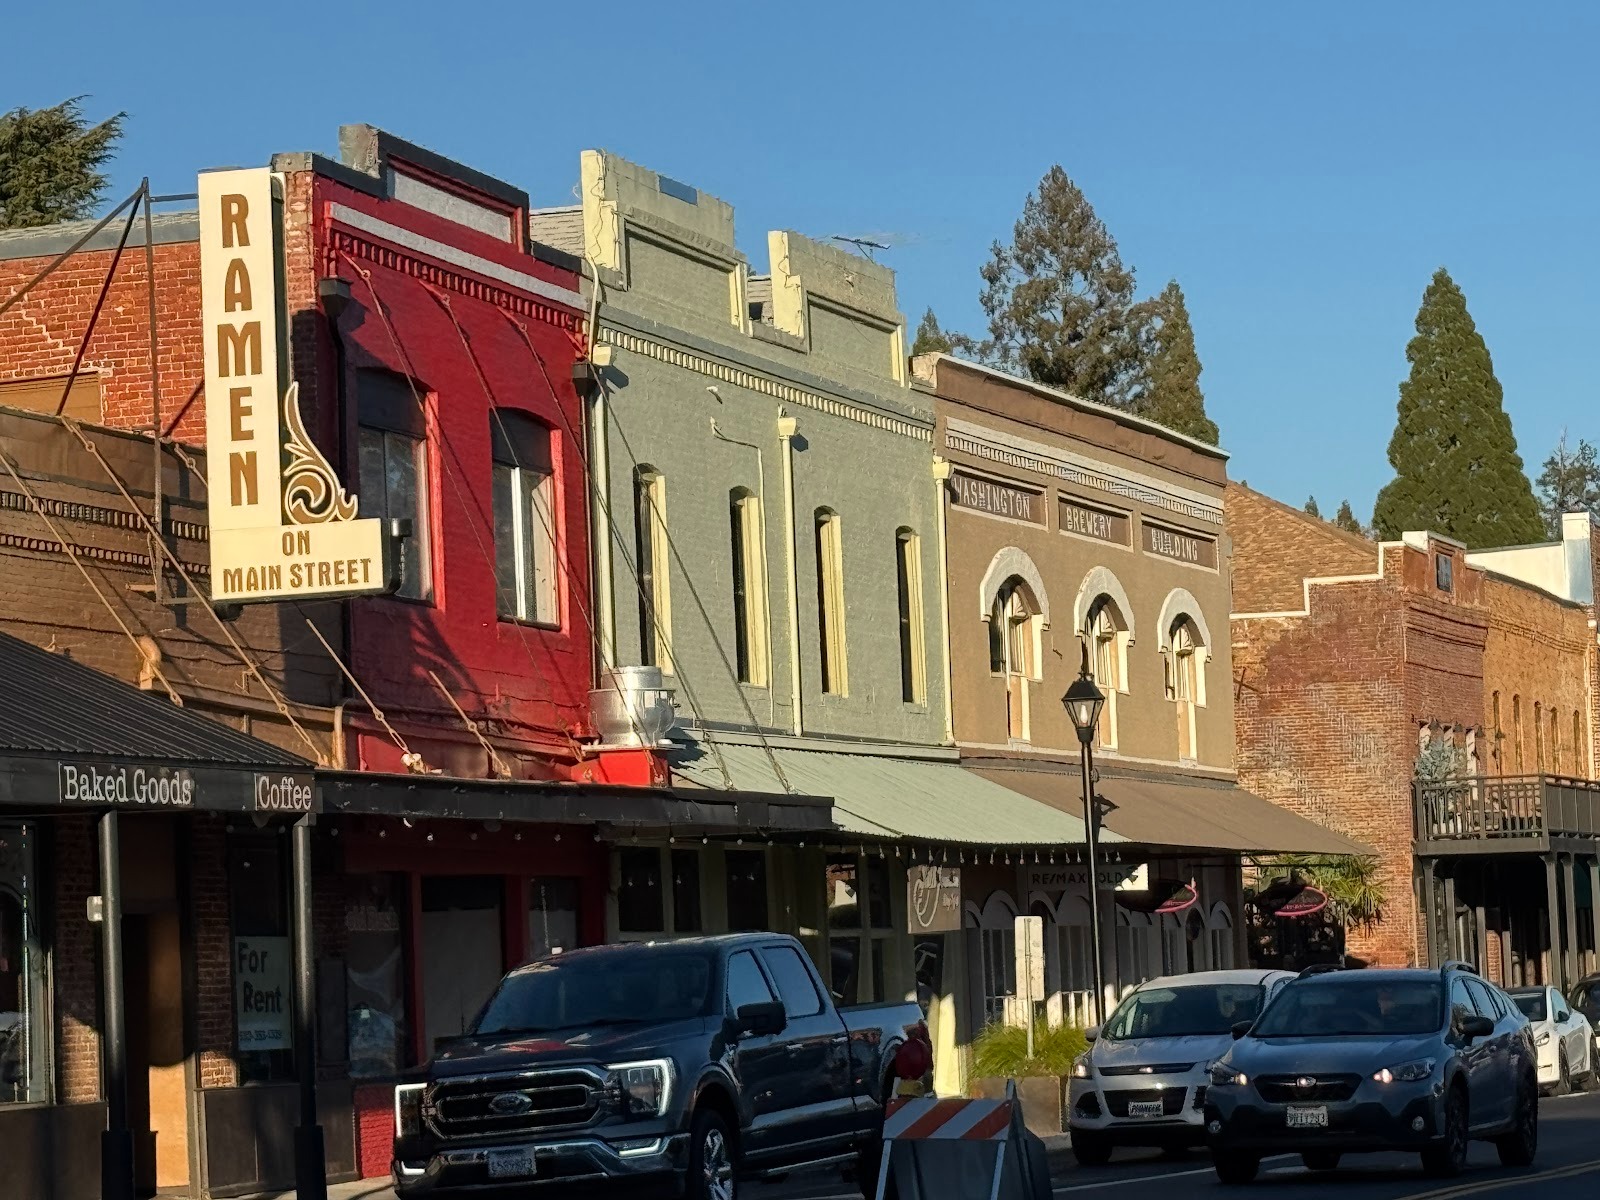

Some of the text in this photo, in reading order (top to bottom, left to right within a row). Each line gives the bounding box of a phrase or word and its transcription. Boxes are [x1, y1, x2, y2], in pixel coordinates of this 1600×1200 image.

[217, 193, 263, 507] RAMEN
[1066, 506, 1112, 539] BREWERY
[282, 530, 311, 556] ON
[1151, 528, 1198, 561] BUILDING
[223, 558, 371, 593] MAIN STREET
[64, 766, 192, 804] Baked Goods
[258, 776, 312, 810] Coffee
[1031, 871, 1123, 884] RE/MAX OLD
[238, 941, 268, 974] For
[243, 981, 283, 1014] Rent
